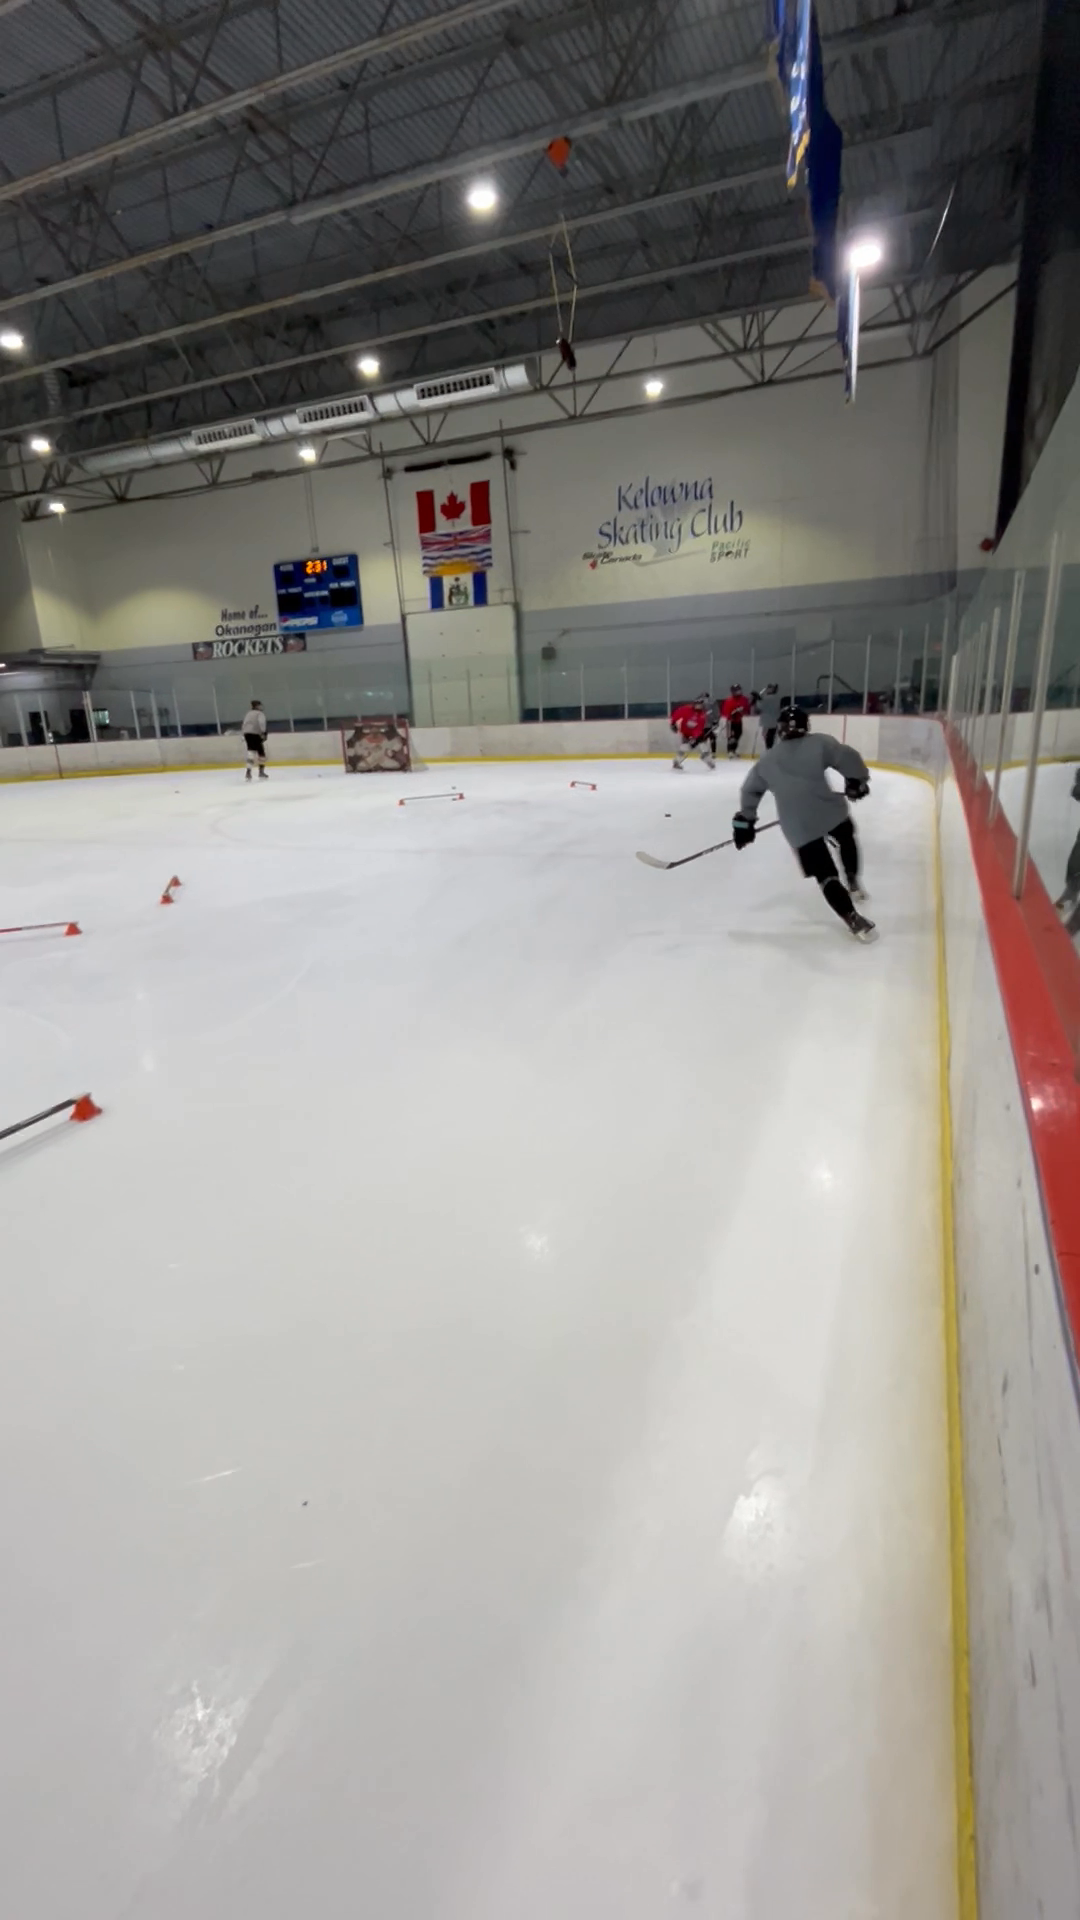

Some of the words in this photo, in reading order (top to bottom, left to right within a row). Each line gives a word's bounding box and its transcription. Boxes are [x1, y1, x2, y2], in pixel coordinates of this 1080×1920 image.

[617, 475, 714, 512] Kelowna
[598, 514, 683, 554] Skating
[690, 500, 743, 538] Club
[220, 608, 246, 622] Home
[215, 622, 277, 636] Okanagan
[212, 636, 284, 659] ROCKETS
